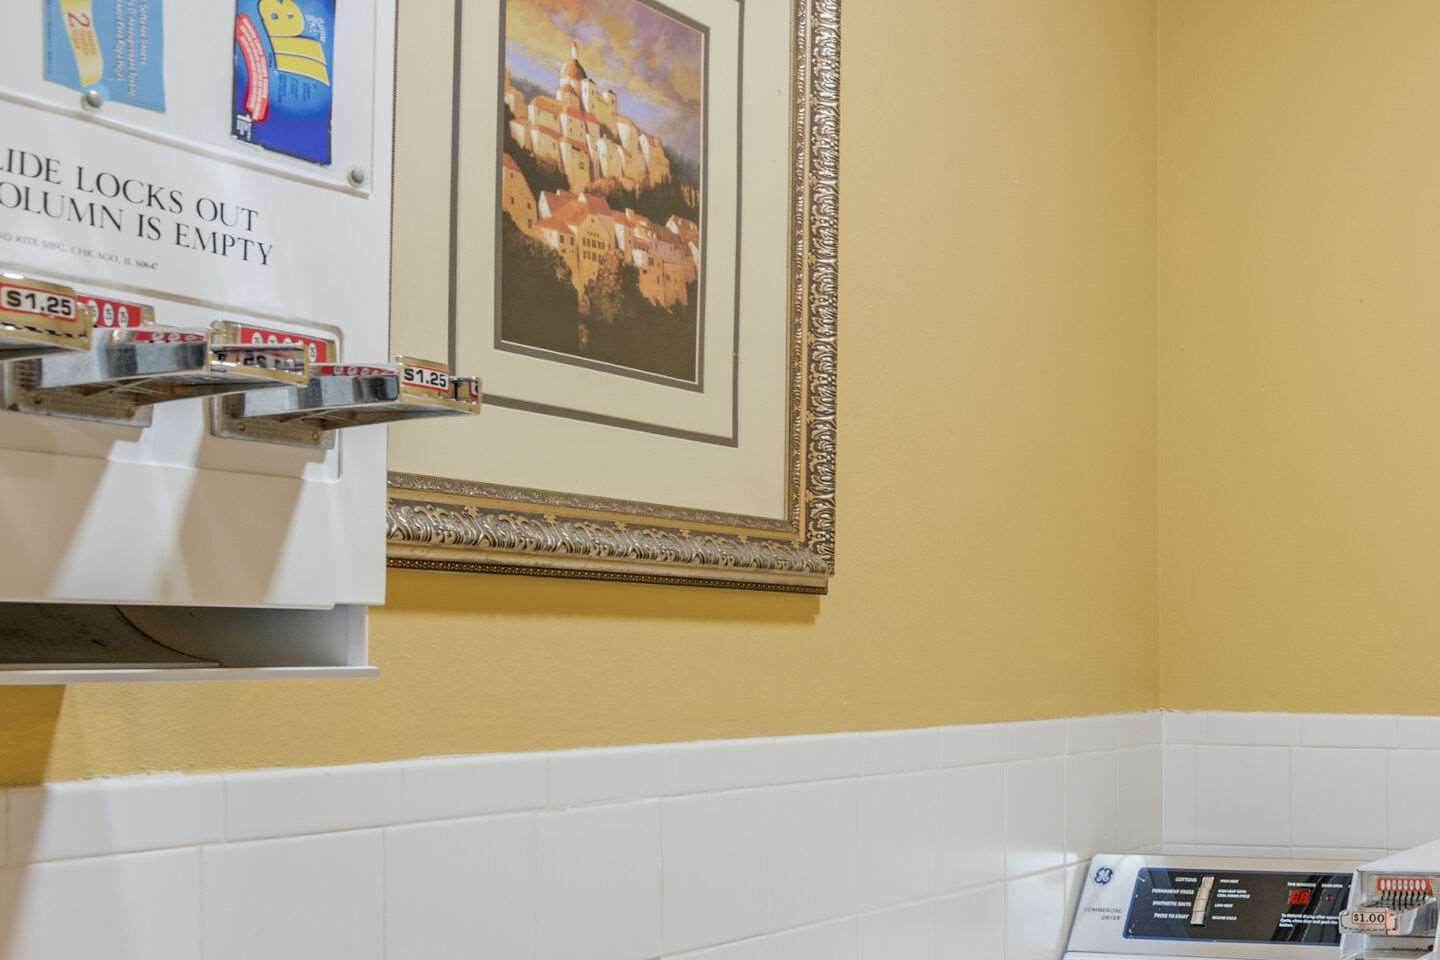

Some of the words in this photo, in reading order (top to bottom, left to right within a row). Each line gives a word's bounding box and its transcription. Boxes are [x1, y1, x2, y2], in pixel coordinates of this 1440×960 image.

[0, 148, 61, 184] IDE
[77, 166, 183, 215] LOCKS
[196, 197, 259, 231] OUT
[137, 213, 162, 241] IS
[175, 222, 273, 265] EMPTY
[1353, 912, 1385, 923] $1.00
